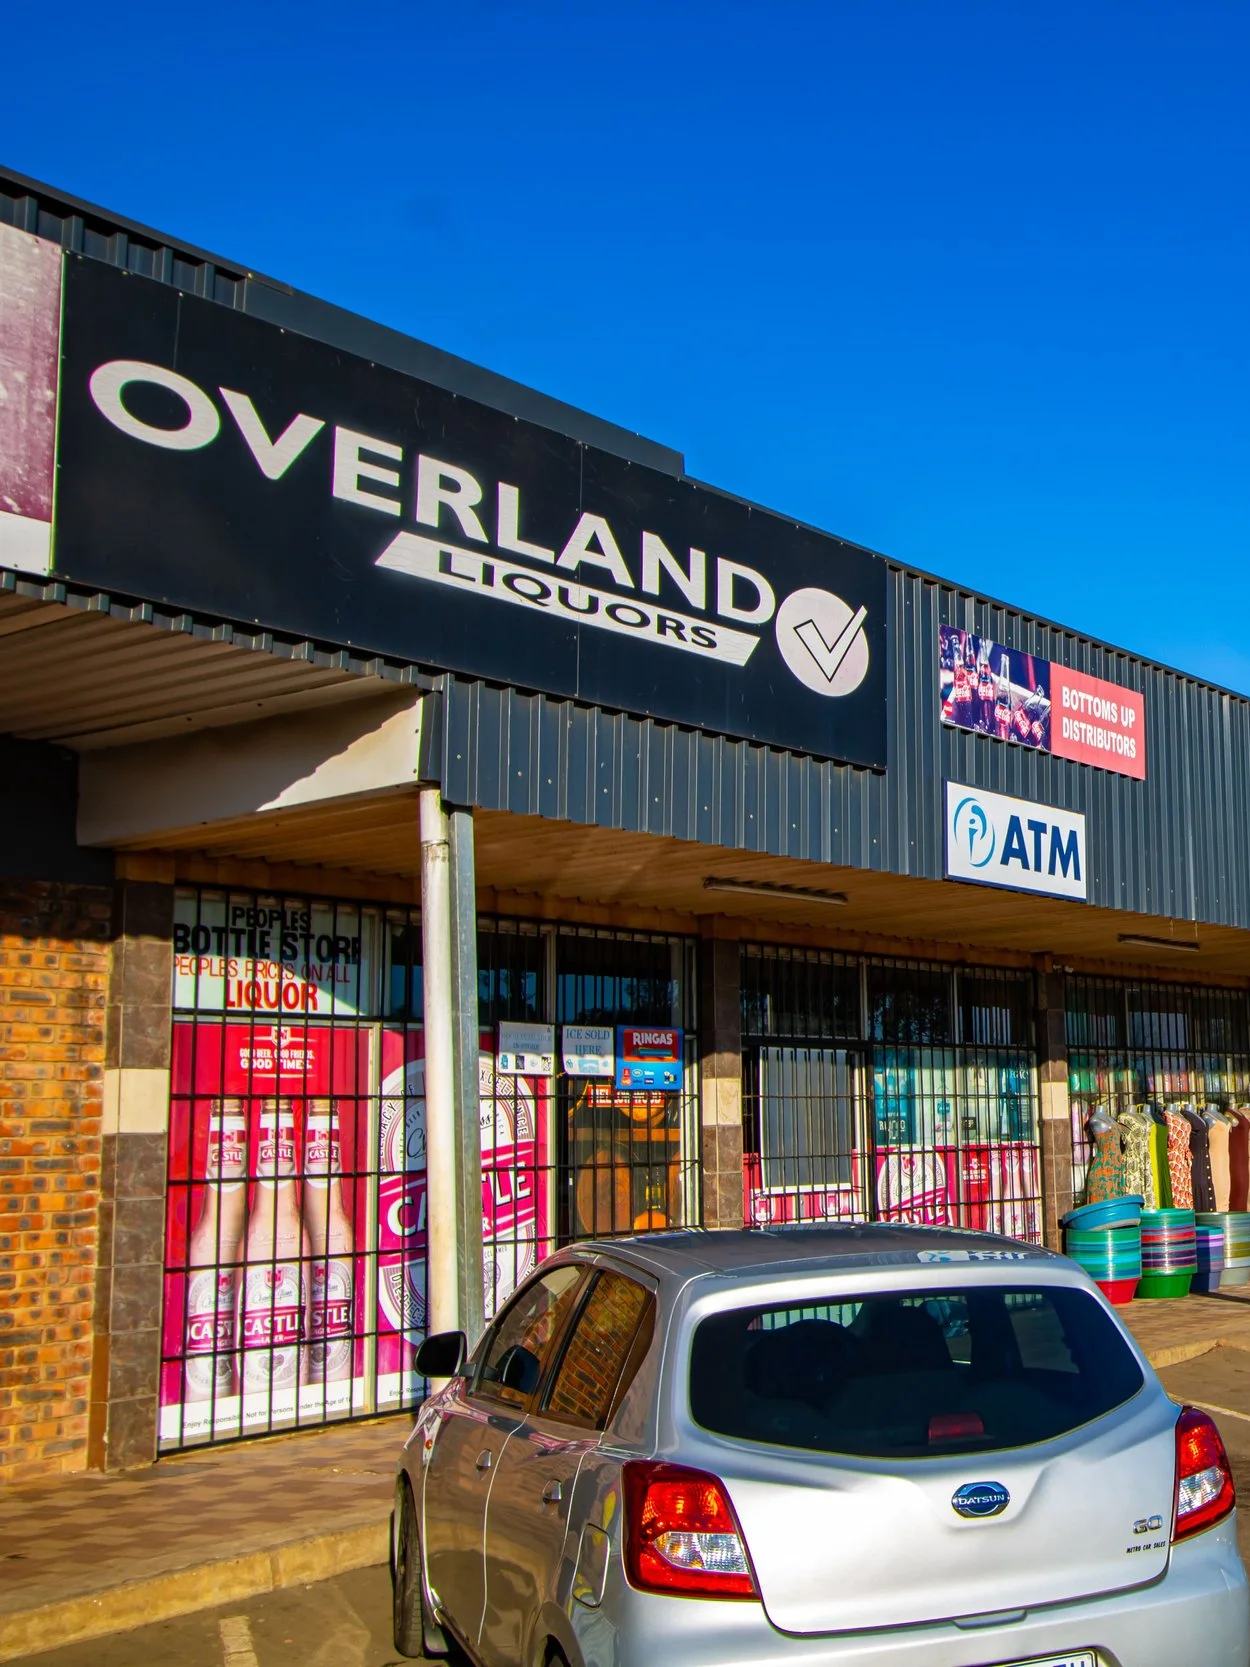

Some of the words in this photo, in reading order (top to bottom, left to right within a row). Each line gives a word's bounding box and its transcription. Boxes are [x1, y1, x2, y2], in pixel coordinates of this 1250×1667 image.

[89, 360, 776, 624] OVERLAND
[439, 550, 718, 651] LIQUORS
[1062, 686, 1118, 721] BOTTOMS
[1121, 708, 1136, 729] UP
[1062, 717, 1136, 759] DISTRIBUTORS
[1000, 815, 1081, 881] ATM
[232, 906, 312, 931] PEOPLES
[174, 956, 238, 978] PEOPLES
[226, 979, 319, 1011] LIQUOR
[566, 1028, 584, 1040] ICE
[586, 1028, 610, 1041] SOLD
[633, 1032, 673, 1045] RINGAS
[575, 1044, 602, 1056] HERE
[212, 1151, 242, 1162] CSTLE
[260, 1334, 284, 1344] LAER
[959, 1494, 1005, 1505] DATSUN
[1132, 1514, 1163, 1534] GO
[1142, 1543, 1152, 1551] CAR
